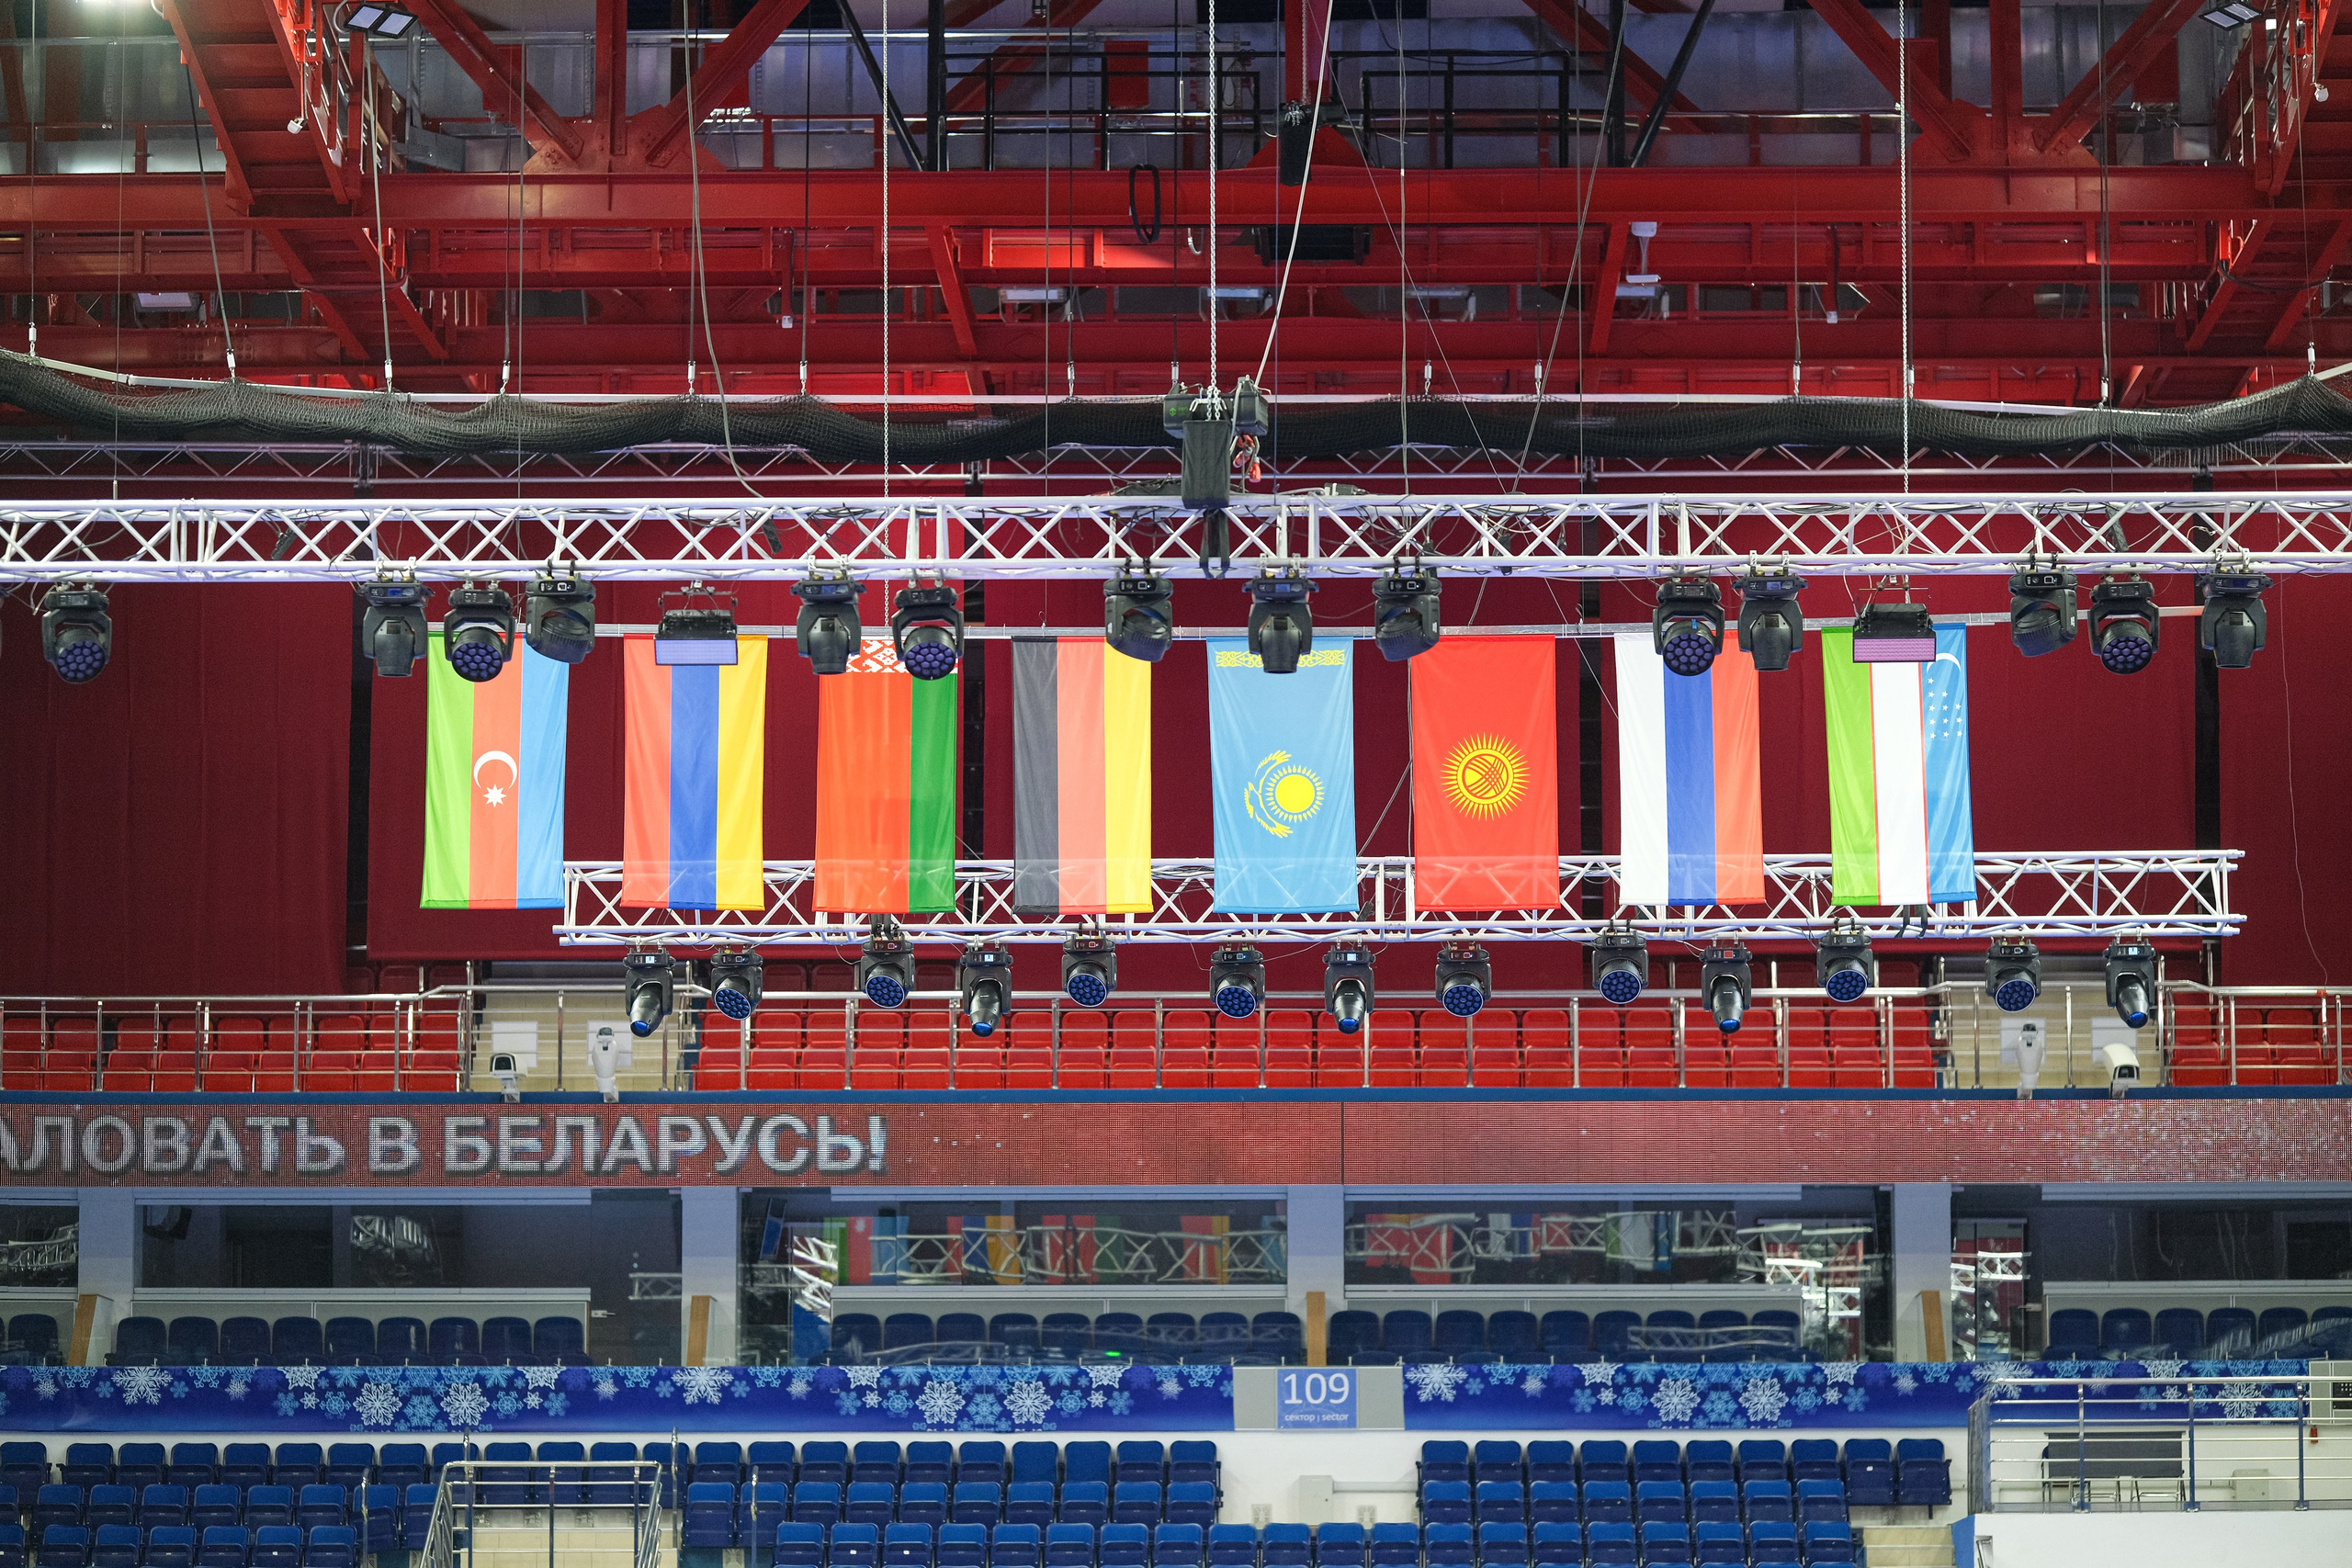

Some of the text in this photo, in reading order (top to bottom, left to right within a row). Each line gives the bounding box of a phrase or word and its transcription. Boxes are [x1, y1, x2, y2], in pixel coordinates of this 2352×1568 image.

[368, 1116, 422, 1171] В
[444, 1114, 887, 1173] БЕЛАРУСЬ!
[1283, 1373, 1350, 1404] 109
[1284, 1412, 1350, 1422] сектор sector
